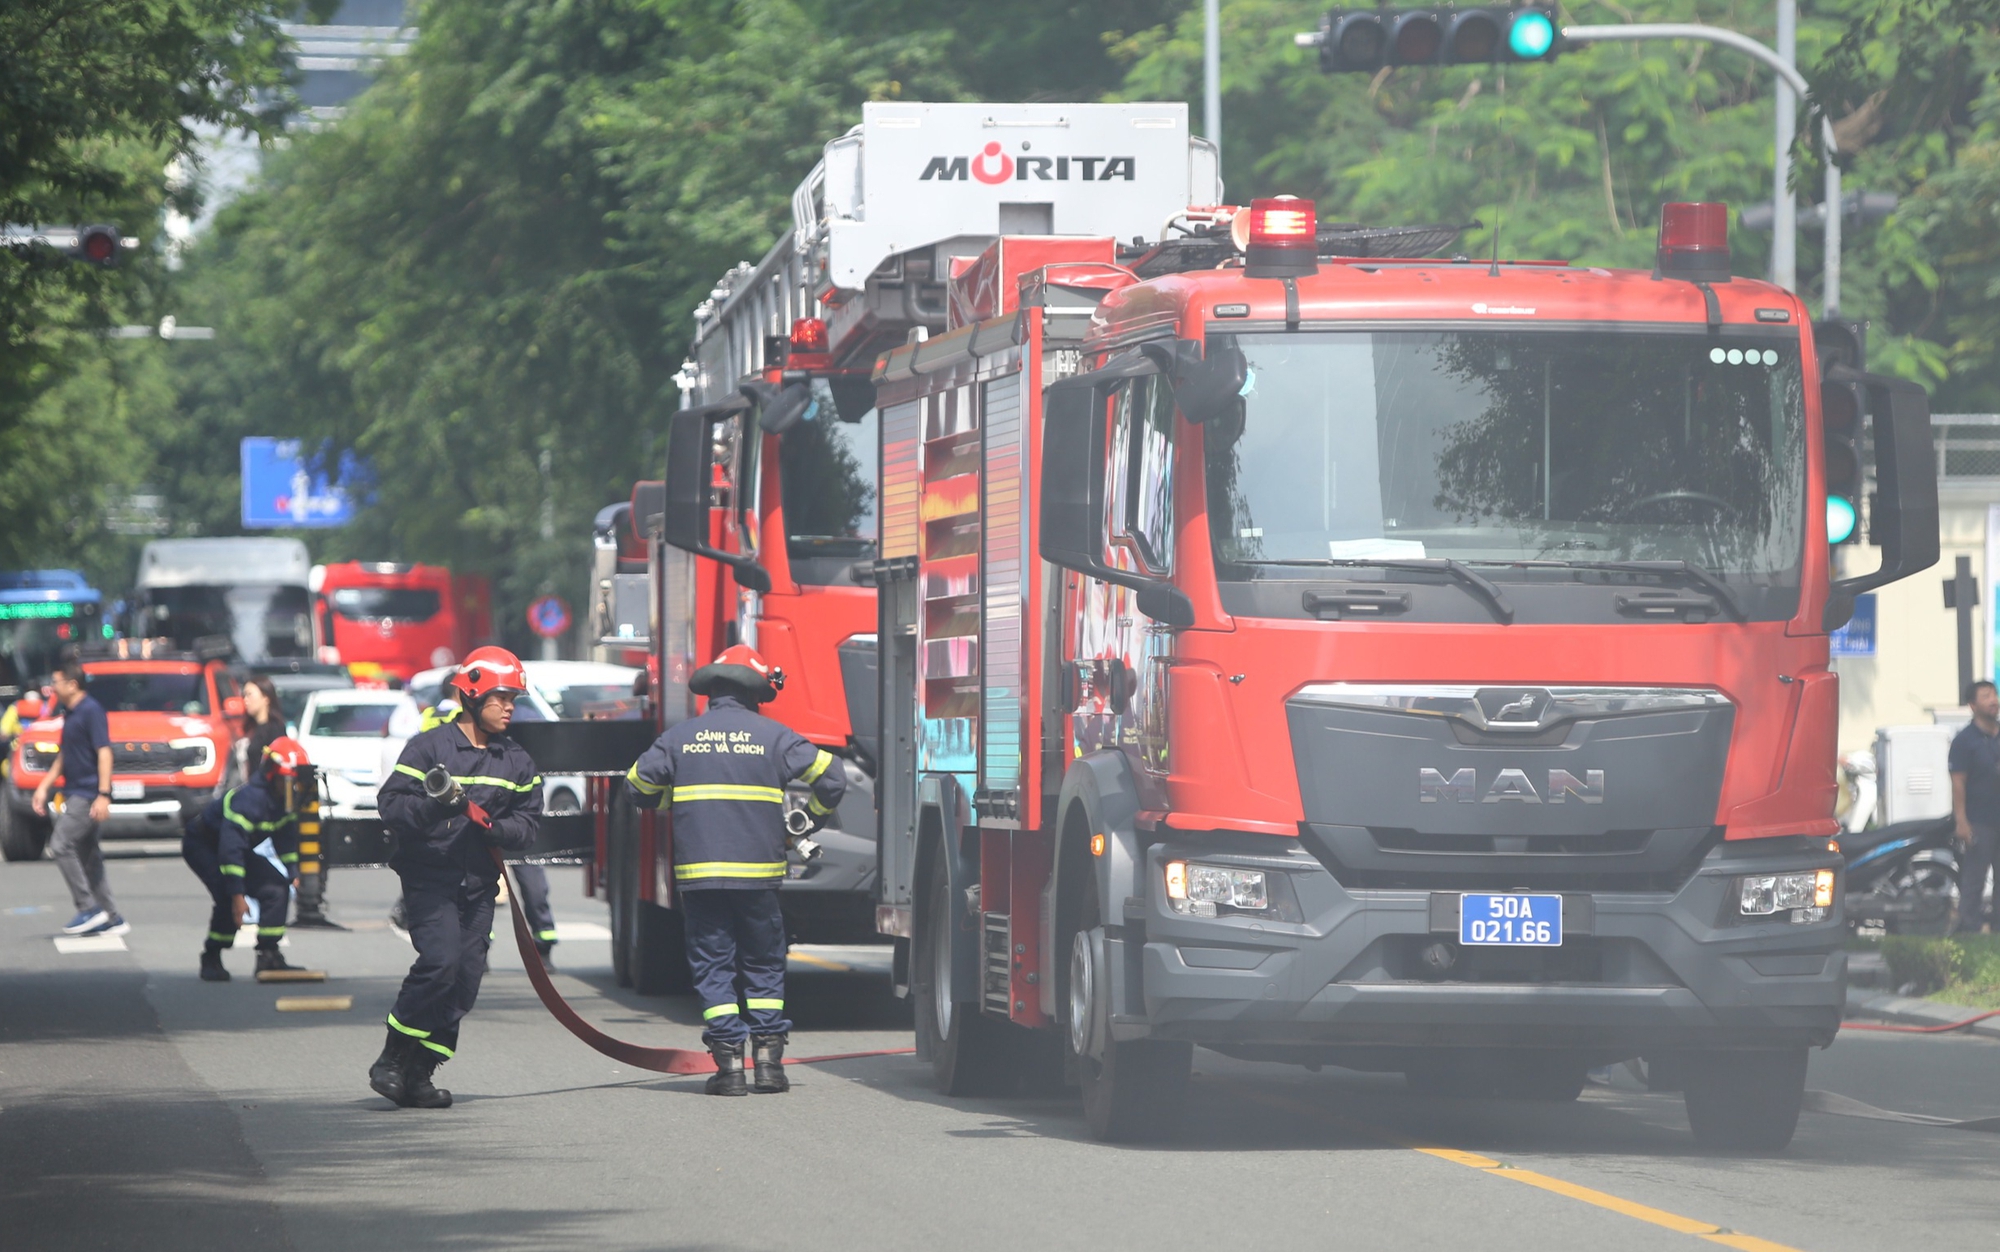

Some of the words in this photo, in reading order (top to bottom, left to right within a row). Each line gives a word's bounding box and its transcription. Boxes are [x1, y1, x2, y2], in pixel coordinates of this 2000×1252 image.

[918, 141, 1136, 185] MORITA
[695, 729, 727, 742] CẢNH
[729, 730, 751, 743] SÁT
[682, 743, 711, 754] PCCC
[715, 741, 730, 753] VÀ
[733, 744, 765, 755] CNCH
[1420, 767, 1605, 804] MAN
[1489, 897, 1533, 919] 50A
[1472, 920, 1551, 943] 021.66
